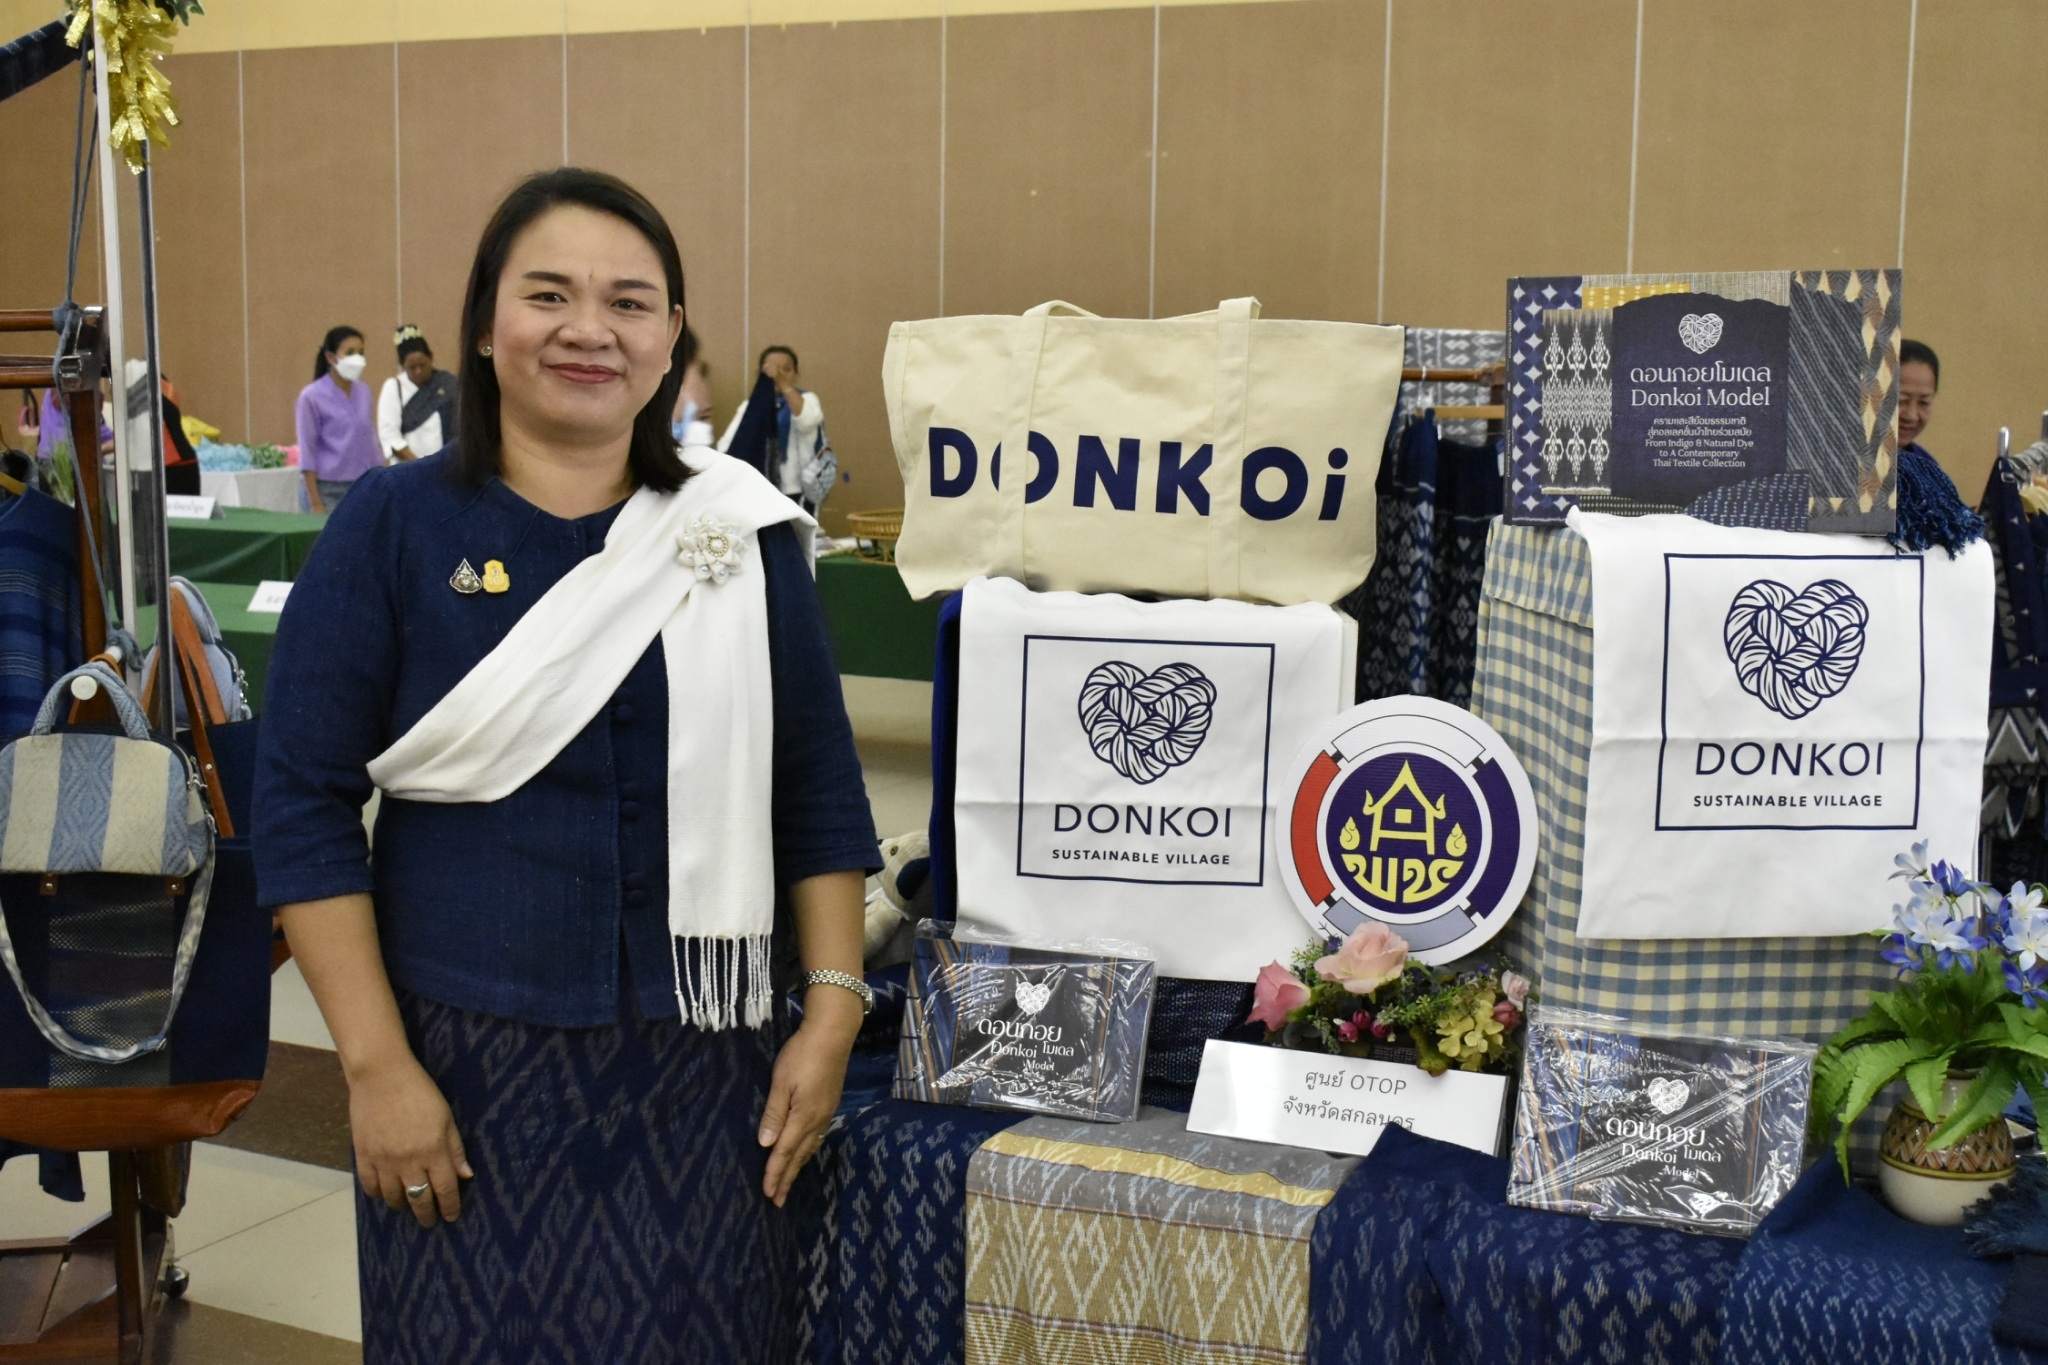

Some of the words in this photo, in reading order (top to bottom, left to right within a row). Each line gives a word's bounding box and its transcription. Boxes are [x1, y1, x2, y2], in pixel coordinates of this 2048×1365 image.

[1630, 360, 1771, 382] ดอนกอยโมเดล
[1631, 386, 1701, 406] Donkoi
[1706, 386, 1770, 406] Model
[1645, 438, 1667, 448] From
[1668, 438, 1694, 450] Indigo
[1703, 438, 1736, 448] Natural
[1737, 438, 1755, 450] Dye
[1653, 459, 1671, 468] Thai
[1672, 459, 1701, 468] Textile
[1702, 459, 1746, 468] Collection
[1659, 449, 1669, 457] to
[1669, 449, 1677, 457] A
[1678, 449, 1741, 460] Contemporary
[1696, 742, 1884, 776] DONKOI
[1694, 795, 1808, 807] SUSTAINABLE
[1813, 795, 1883, 807] VILLAGE
[1054, 803, 1231, 837] DONKOI
[1052, 849, 1160, 864] SUSTAINABLE
[1165, 853, 1231, 865] VILLAGE
[978, 1018, 1062, 1042] ดอนกอย
[990, 1040, 1038, 1058] Donkoi
[1043, 1040, 1074, 1057] โมเดล
[1025, 1059, 1055, 1071] Model
[1305, 1069, 1346, 1090] ศูนย์
[1350, 1074, 1407, 1095] OTOP
[1606, 1117, 1705, 1146] ดอนกอย
[1622, 1142, 1677, 1163] Donkoi
[1684, 1144, 1722, 1163] โมเดล
[1664, 1164, 1699, 1179] Model
